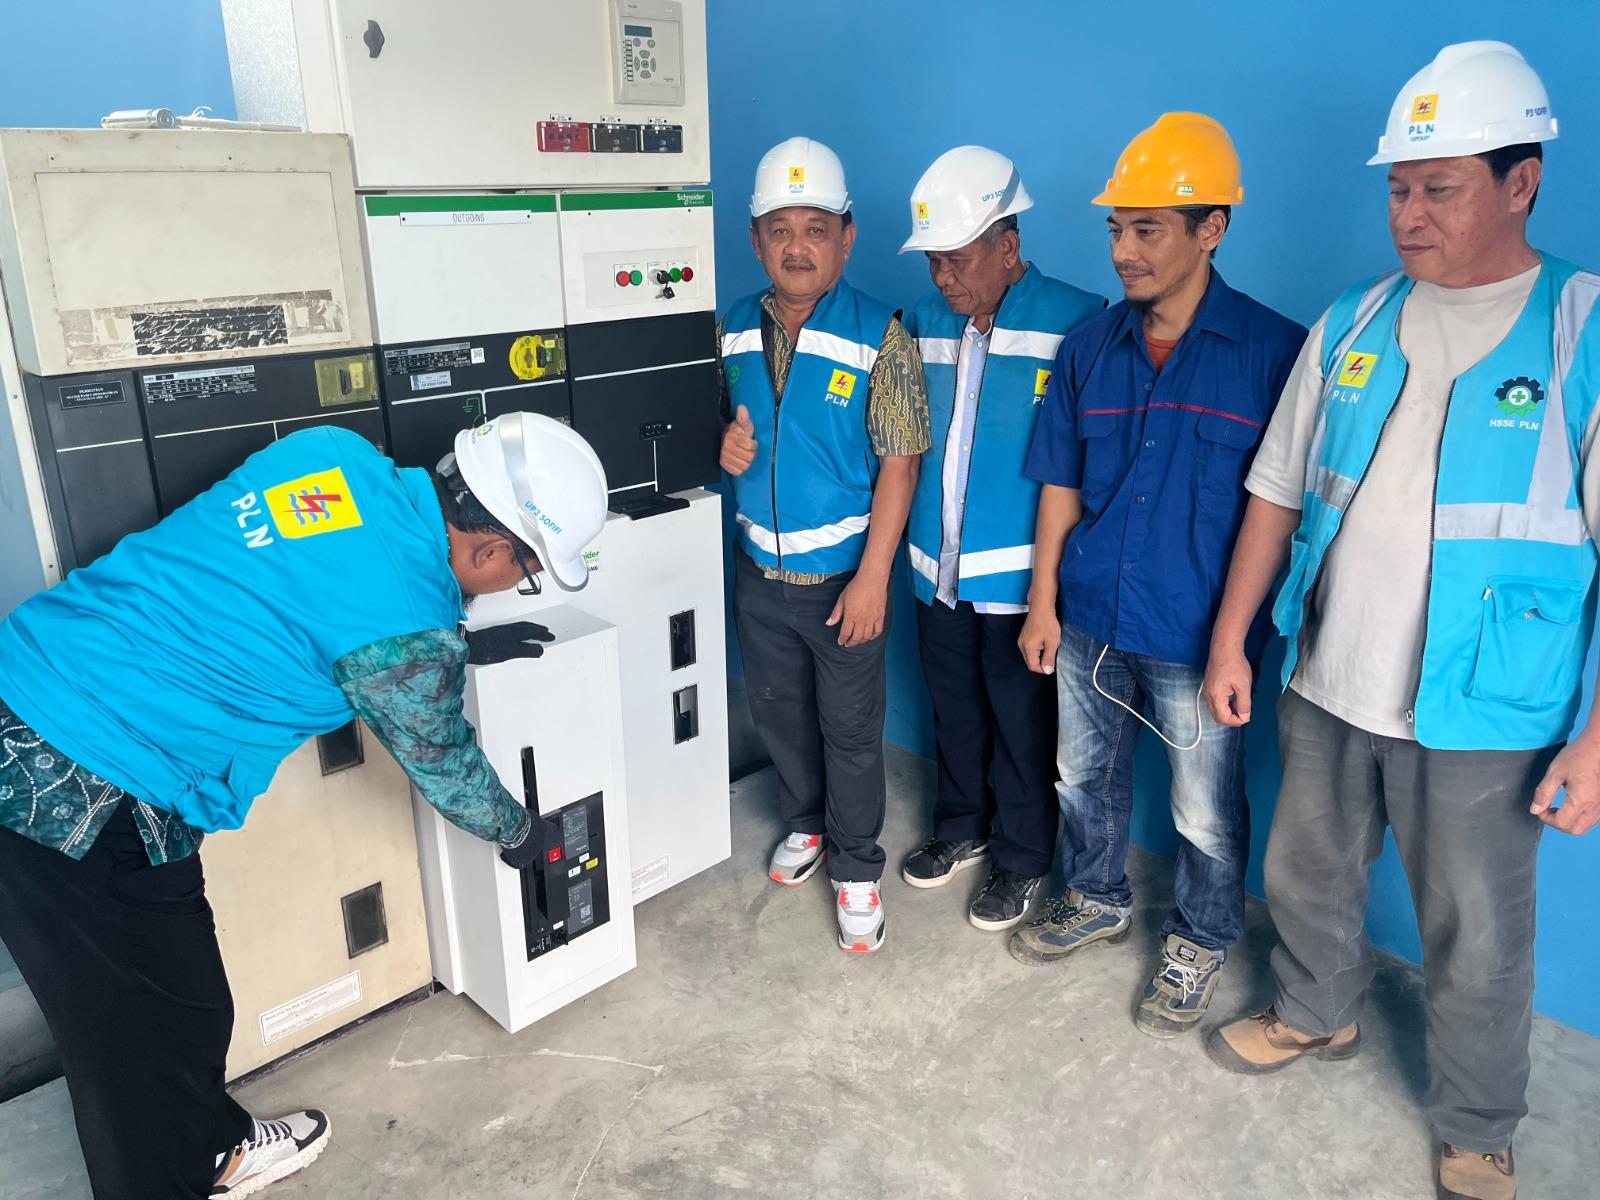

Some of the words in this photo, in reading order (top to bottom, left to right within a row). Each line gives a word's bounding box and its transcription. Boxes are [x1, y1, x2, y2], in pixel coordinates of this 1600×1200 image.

[1408, 124, 1434, 135] PLN
[676, 193, 705, 204] Schneider
[824, 393, 849, 408] PLN
[1332, 390, 1361, 404] PLN
[1489, 419, 1516, 428] HSSE
[1519, 420, 1539, 431] PLN
[524, 500, 540, 517] UP3
[231, 491, 274, 549] PLN
